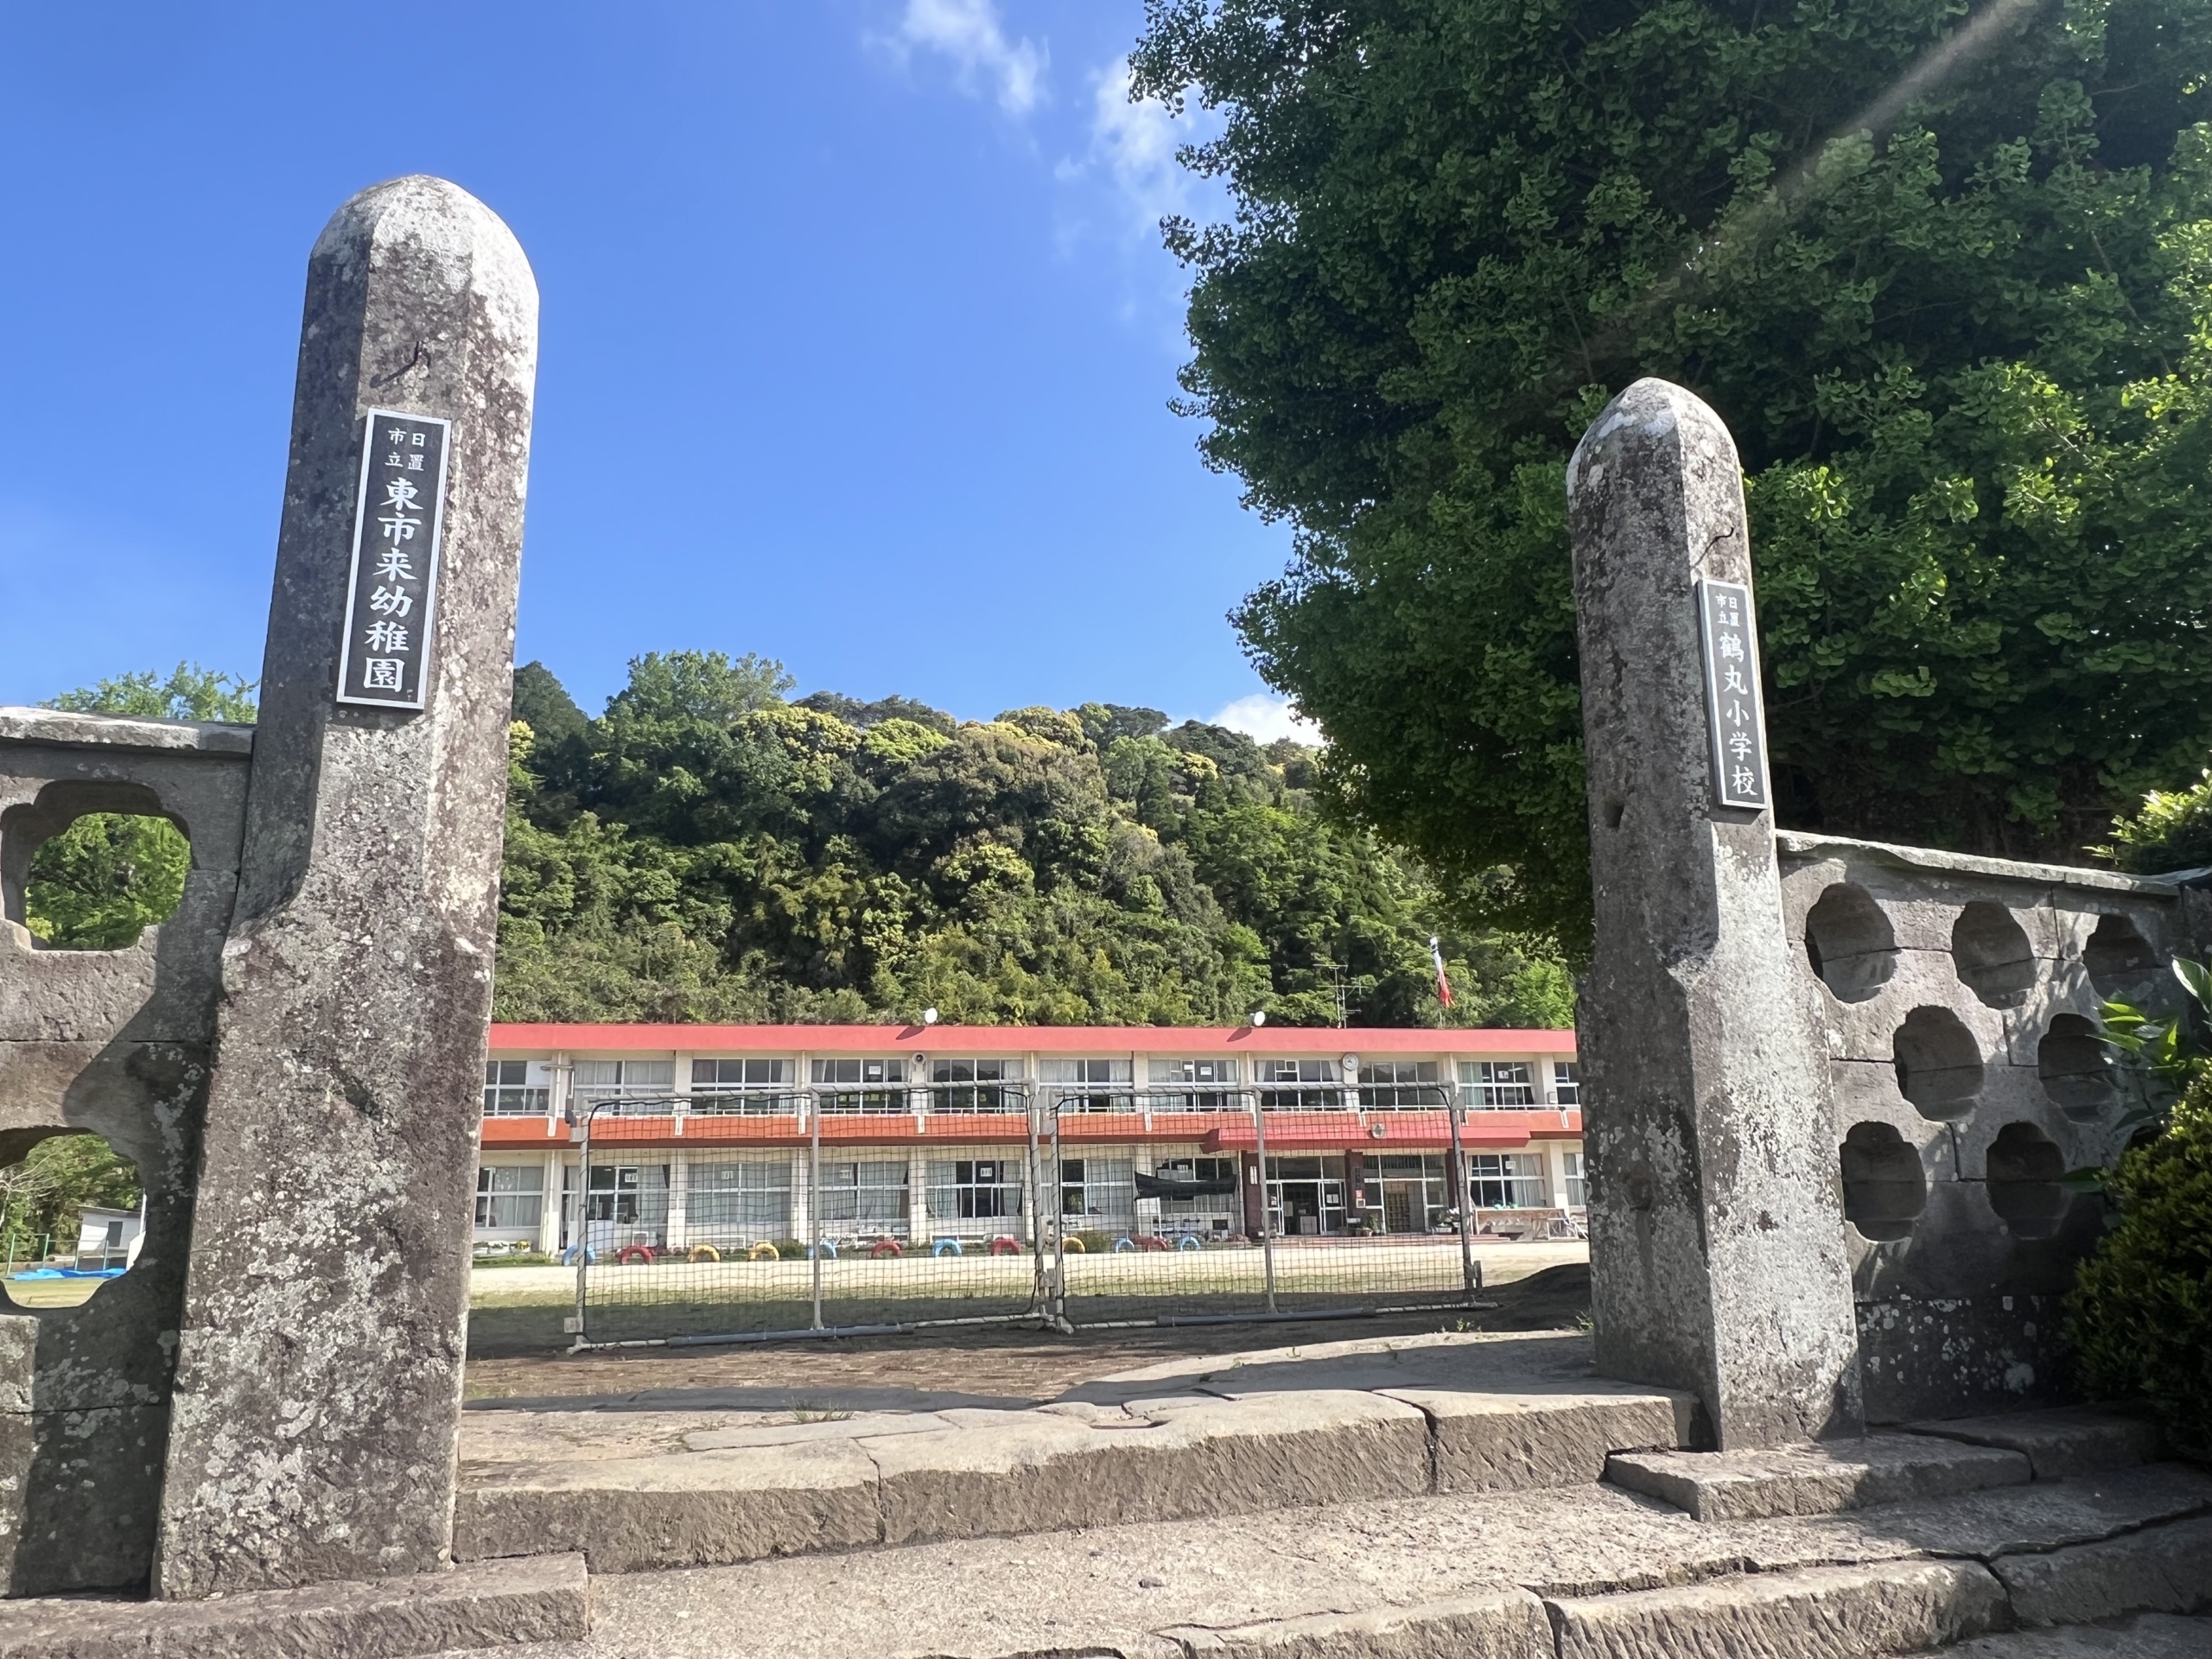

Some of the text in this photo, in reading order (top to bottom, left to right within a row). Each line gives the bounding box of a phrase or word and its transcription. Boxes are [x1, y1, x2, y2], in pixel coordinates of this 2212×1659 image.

[385, 427, 407, 467] 市立
[363, 477, 423, 692] 東市来幼稚園
[1719, 632, 1758, 796] 鶴丸小学校
